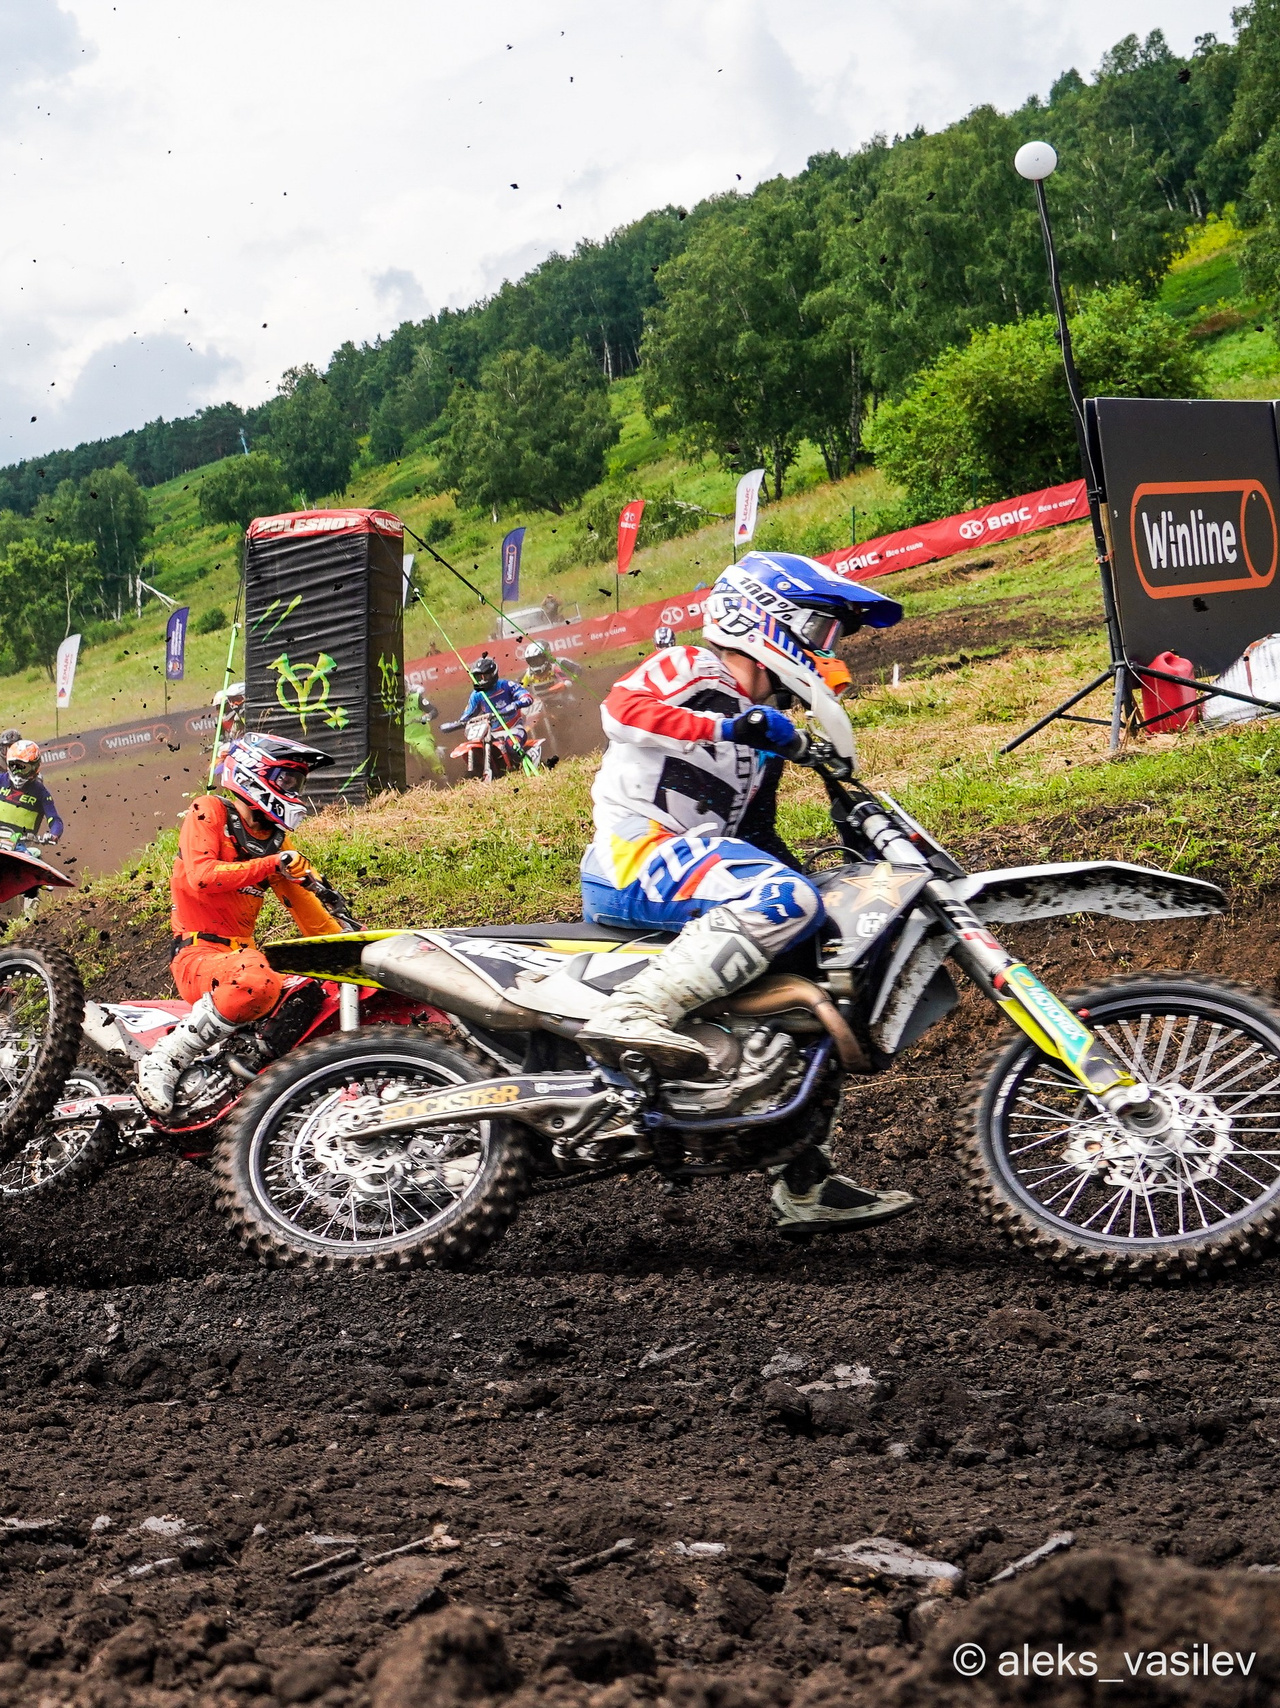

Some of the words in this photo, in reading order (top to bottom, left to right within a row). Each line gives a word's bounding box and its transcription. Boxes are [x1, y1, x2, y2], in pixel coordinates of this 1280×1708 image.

[988, 506, 1032, 531] BAIC
[1141, 508, 1238, 570] Winline
[835, 551, 881, 576] BAIC
[738, 576, 798, 622] 100%
[105, 731, 152, 749] Winline
[0, 786, 38, 806] HIZER
[1025, 985, 1087, 1041] MOTOREX
